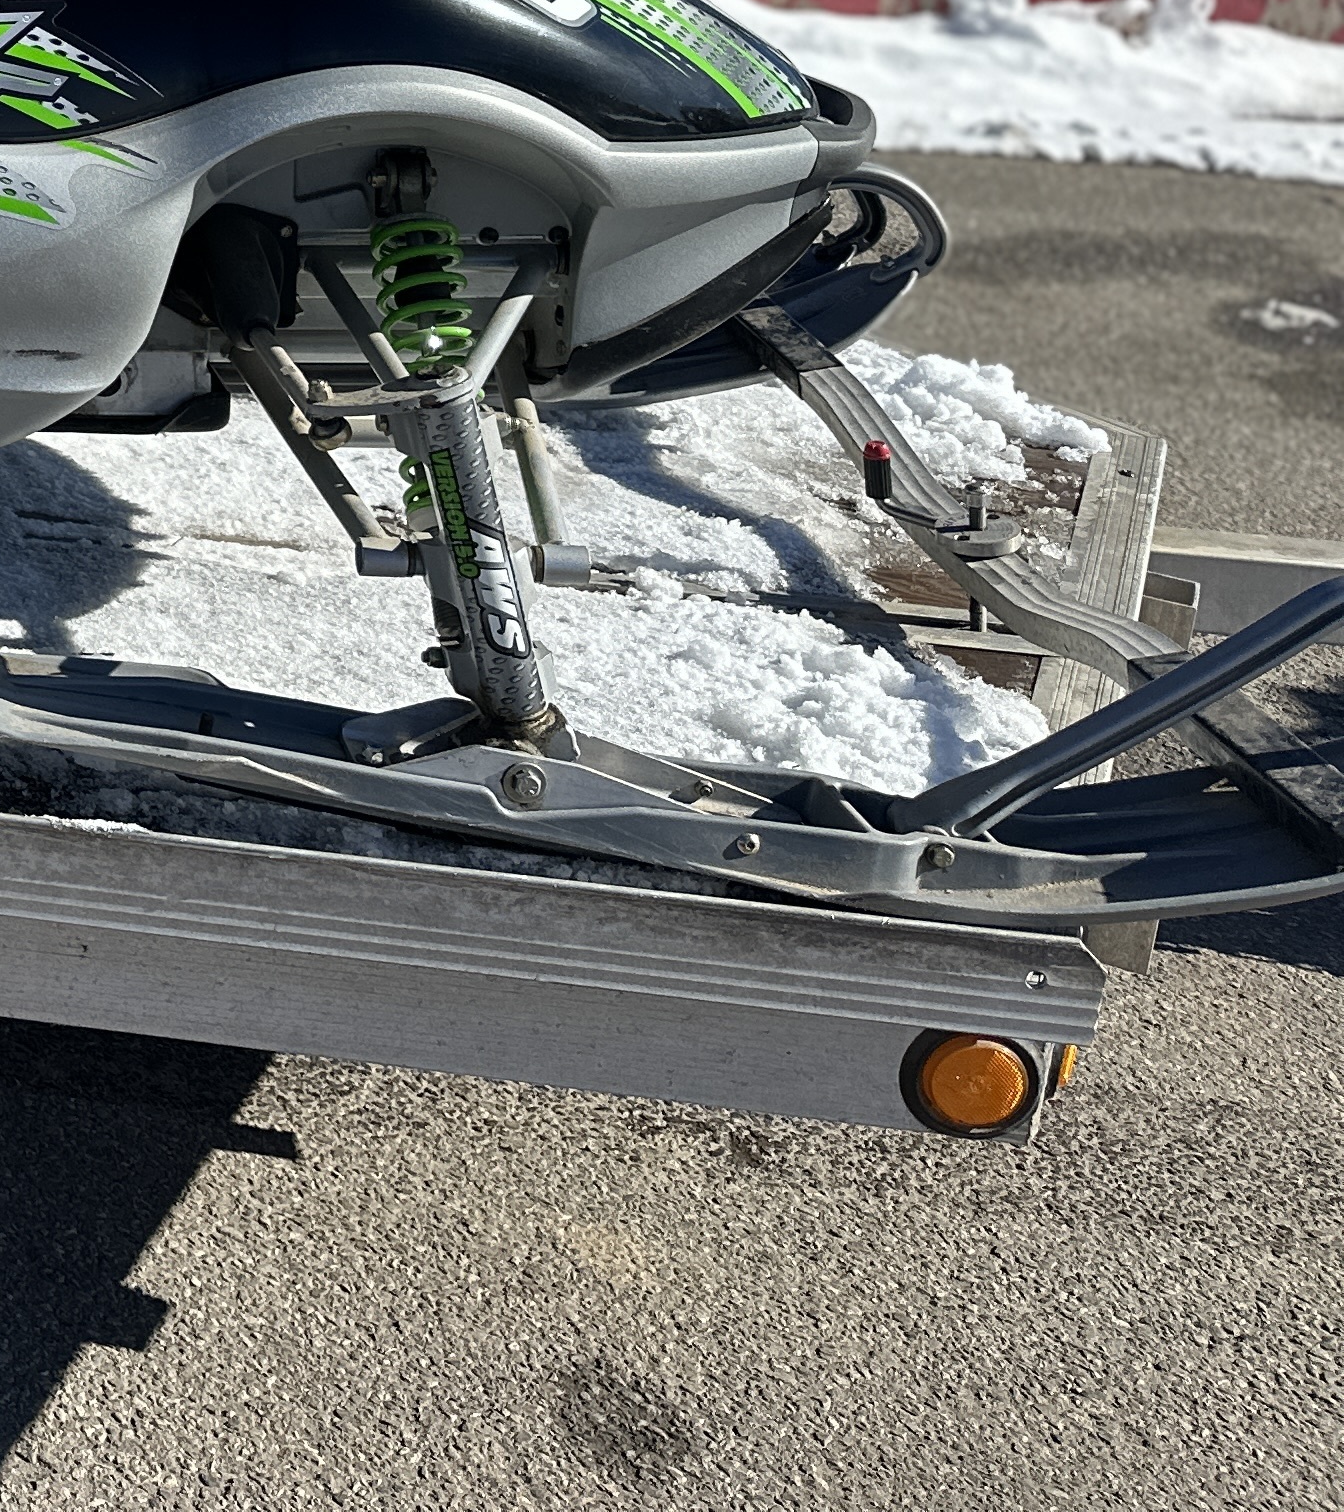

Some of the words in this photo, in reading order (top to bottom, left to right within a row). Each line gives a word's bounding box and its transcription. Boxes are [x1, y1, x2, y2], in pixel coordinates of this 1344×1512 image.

[430, 449, 473, 540] VERSION
[453, 540, 480, 579] 5.0
[468, 528, 527, 654] AWS
